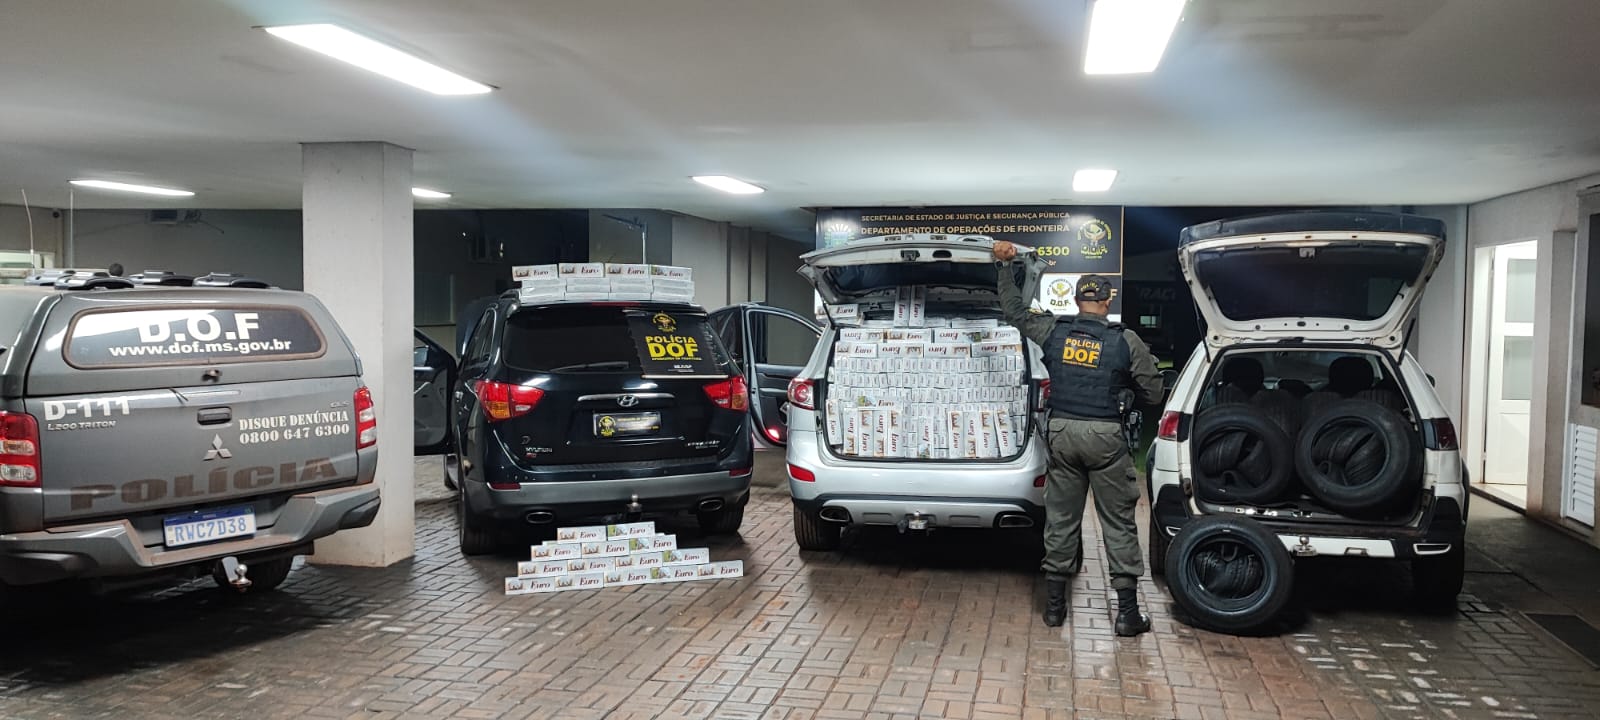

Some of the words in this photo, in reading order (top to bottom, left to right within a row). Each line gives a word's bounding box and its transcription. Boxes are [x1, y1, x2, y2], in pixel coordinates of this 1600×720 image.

[861, 214, 904, 222] SECRETARIA
[916, 213, 944, 221] ESTADO
[955, 212, 985, 222] JUSTIÇA
[993, 211, 1038, 220] SEGURANÇA
[1038, 210, 1070, 219] PÚBLICA
[861, 226, 932, 235] DEPARTAMENTO
[933, 226, 945, 234] DE
[946, 224, 1002, 235] OPERAÇÕES
[1003, 225, 1016, 233] DE
[1017, 223, 1070, 233] FRONTEIRA
[1037, 245, 1070, 256] 6300
[645, 334, 697, 344] POLÍCIA
[1065, 337, 1101, 350] POLÍCIA
[109, 338, 292, 357] www.dof.ms.gov.br
[647, 342, 699, 358] DOF
[1063, 346, 1100, 364] DOF
[43, 399, 131, 421] D-111
[239, 415, 287, 431] DISQUE
[289, 409, 350, 427] DENÚNCIA
[47, 422, 78, 431] L200
[78, 420, 117, 429] TRITON
[239, 429, 280, 445] 0800
[283, 427, 311, 440] 647
[314, 423, 350, 438] 6300
[70, 456, 338, 513] POLÍCIA
[174, 517, 247, 543] RWC7D38
[579, 530, 597, 539] Euro
[629, 526, 646, 535] Euro
[605, 544, 626, 553] Euro
[653, 539, 672, 548] Euro
[554, 548, 571, 556] Euro
[684, 553, 700, 561] Euro
[589, 561, 607, 569] Euro
[639, 557, 659, 565] Euro
[543, 564, 563, 573] Euro
[674, 569, 693, 578] Euro
[720, 566, 739, 574] Euro
[628, 572, 647, 581] Euro
[530, 580, 551, 590] Euro
[579, 577, 600, 587] Euro
